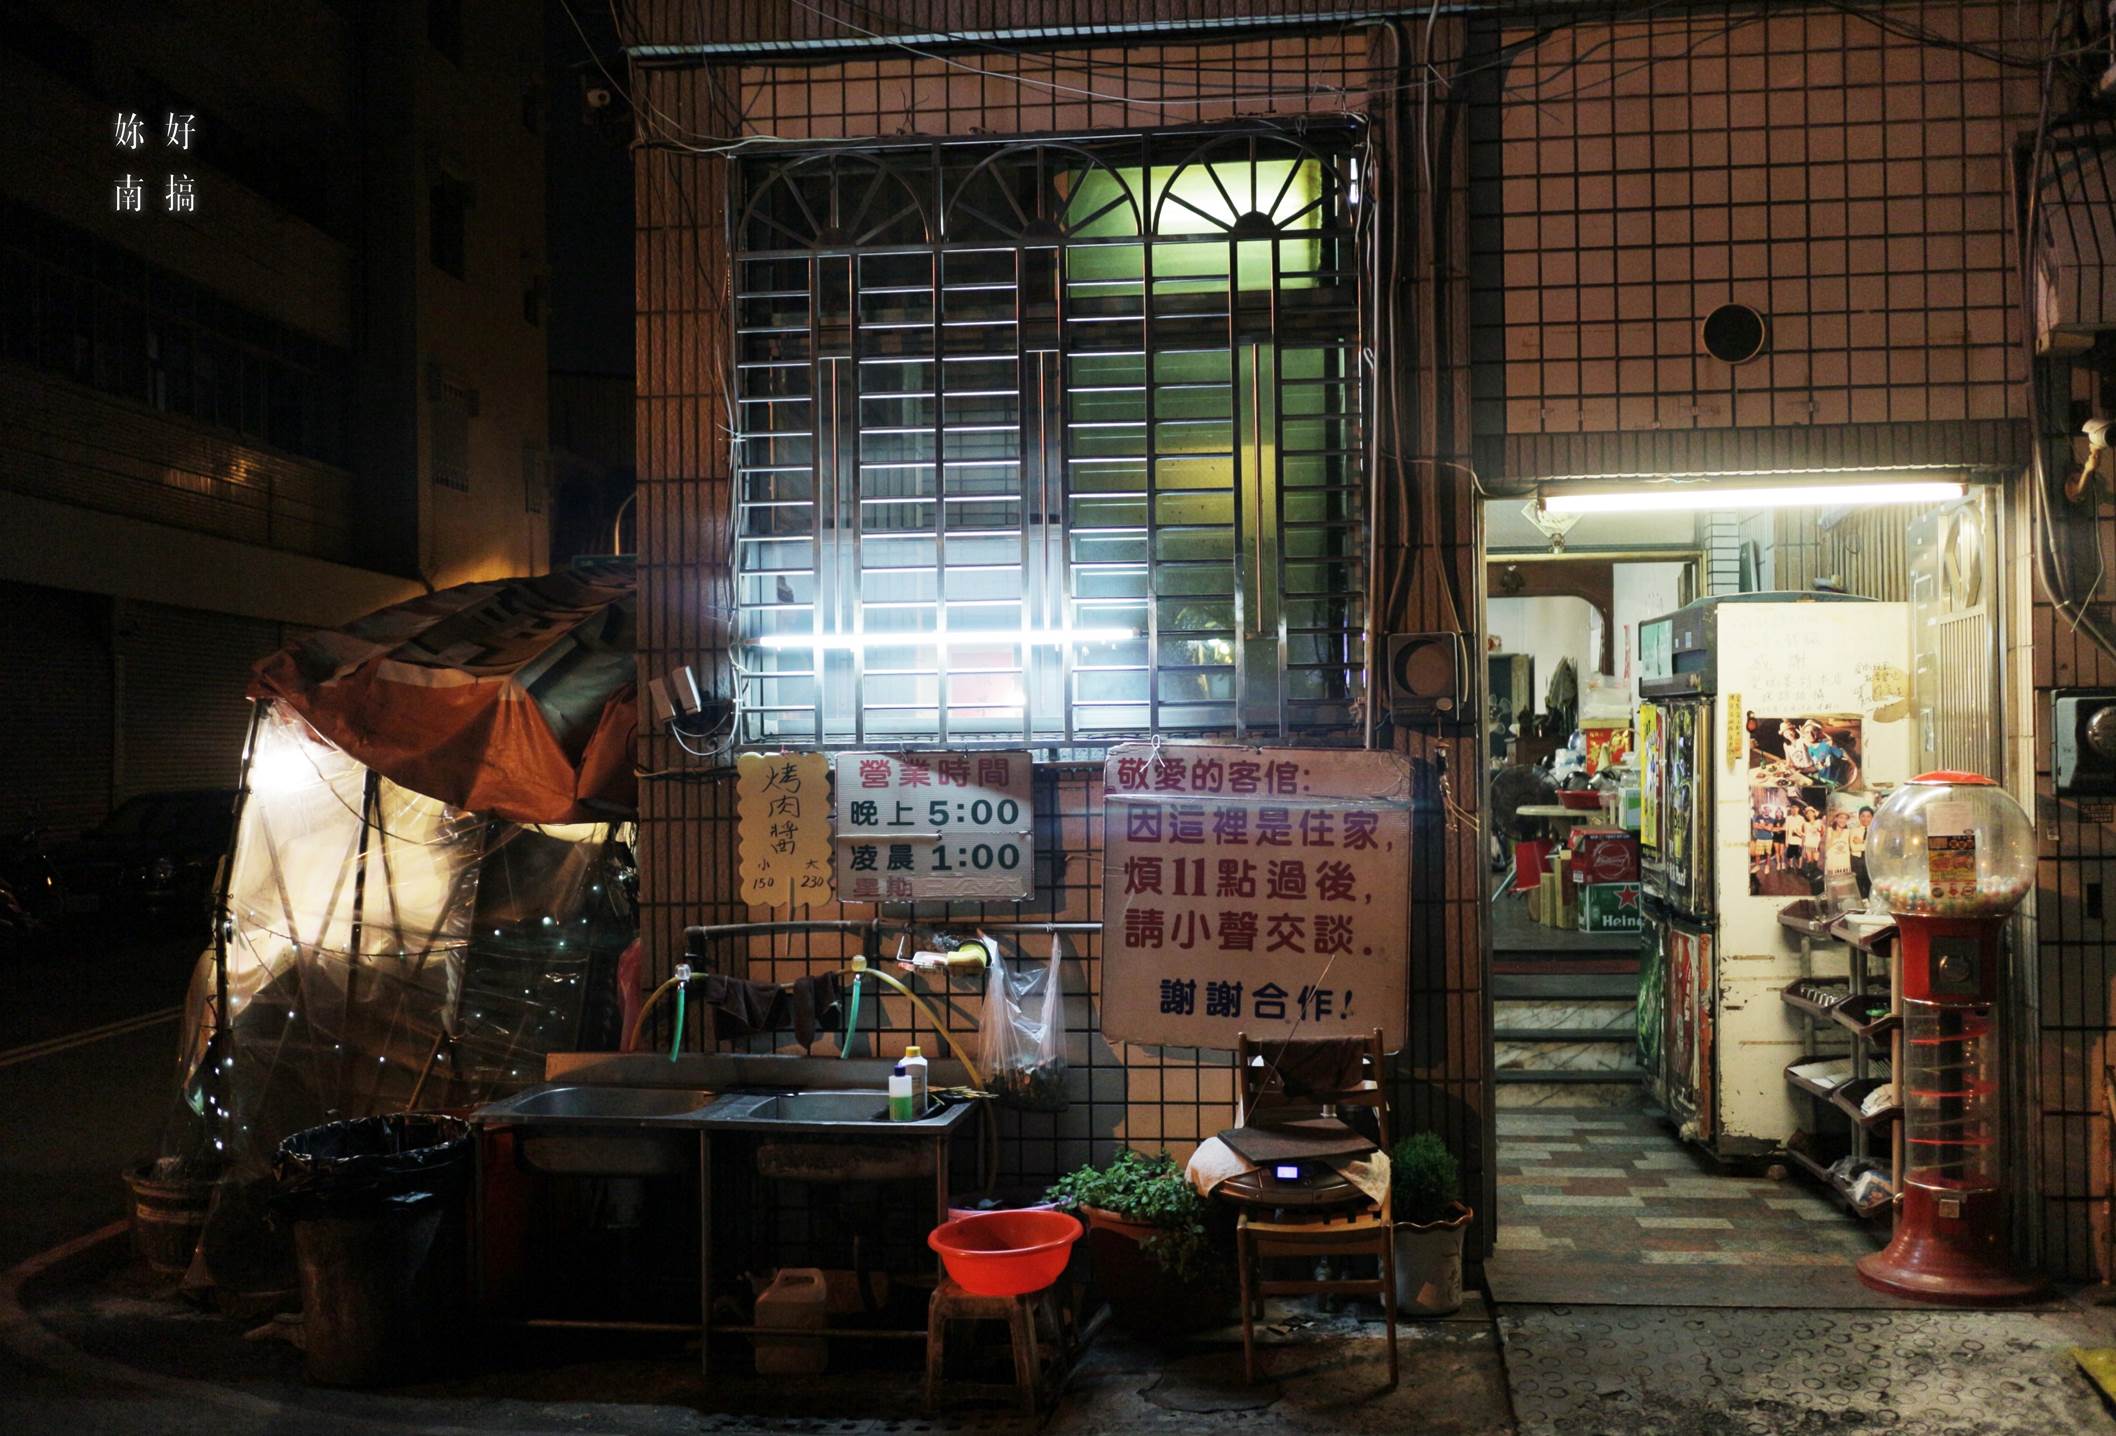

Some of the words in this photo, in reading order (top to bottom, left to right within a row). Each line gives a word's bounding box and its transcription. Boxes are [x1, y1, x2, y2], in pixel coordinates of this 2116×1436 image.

[859, 757, 1010, 789] 營業時間
[752, 877, 775, 890] 150
[800, 874, 824, 889] 230
[1124, 856, 1372, 904] 煩11點過後,
[1159, 978, 1354, 1022] 謝謝合作!
